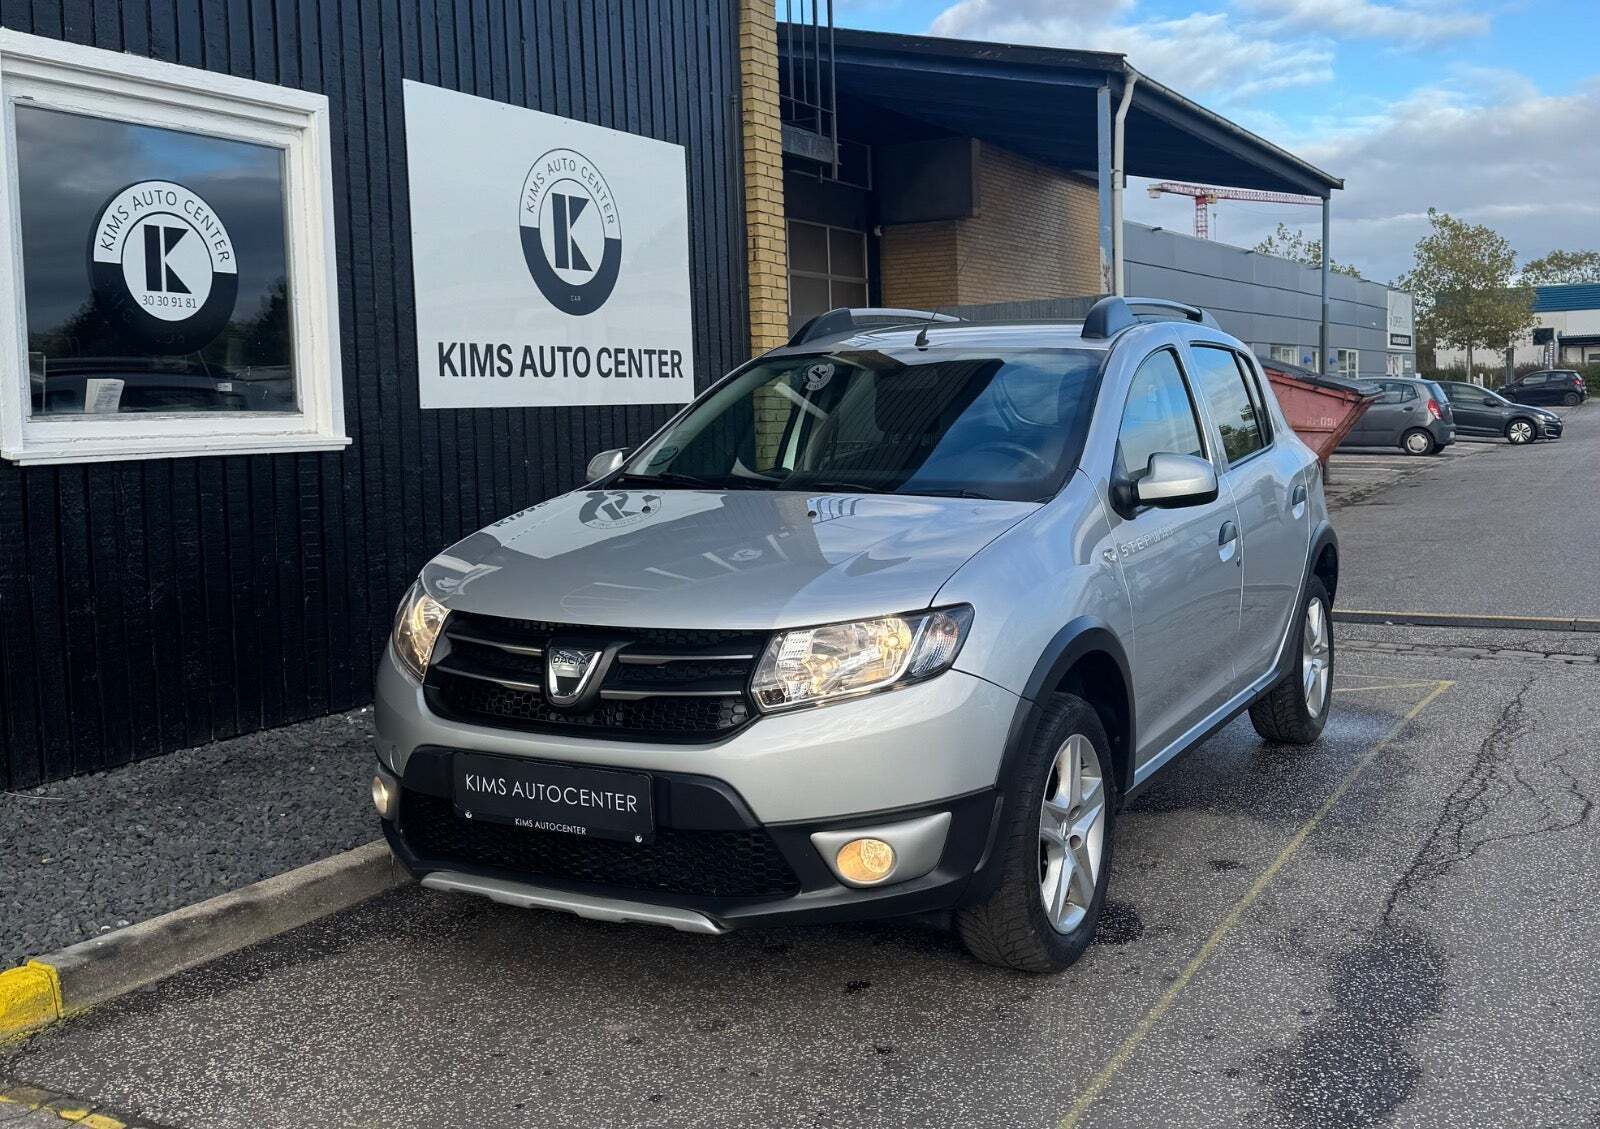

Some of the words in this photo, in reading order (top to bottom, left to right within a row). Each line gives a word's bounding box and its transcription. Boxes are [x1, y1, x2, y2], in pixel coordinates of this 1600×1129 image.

[526, 172, 545, 214] KIMS
[546, 158, 576, 176] AUTO
[581, 166, 615, 225] CENTER
[100, 204, 130, 252] KIMS
[132, 189, 177, 211] AUTO
[184, 199, 230, 263] CENTER
[551, 192, 594, 272] K
[143, 223, 193, 295] K
[142, 295, 155, 306] 30
[157, 296, 169, 307] 30
[171, 297, 183, 308] 91
[185, 298, 197, 309] 81
[437, 341, 514, 377] KIMS
[519, 344, 592, 379] AUTO
[596, 346, 684, 379] CENTER
[553, 655, 587, 666] DACIA
[465, 773, 507, 796] KIMS
[512, 780, 638, 813] AUTOCENTER
[514, 817, 533, 829] KIMS
[534, 820, 587, 836] AUTOCENTER
